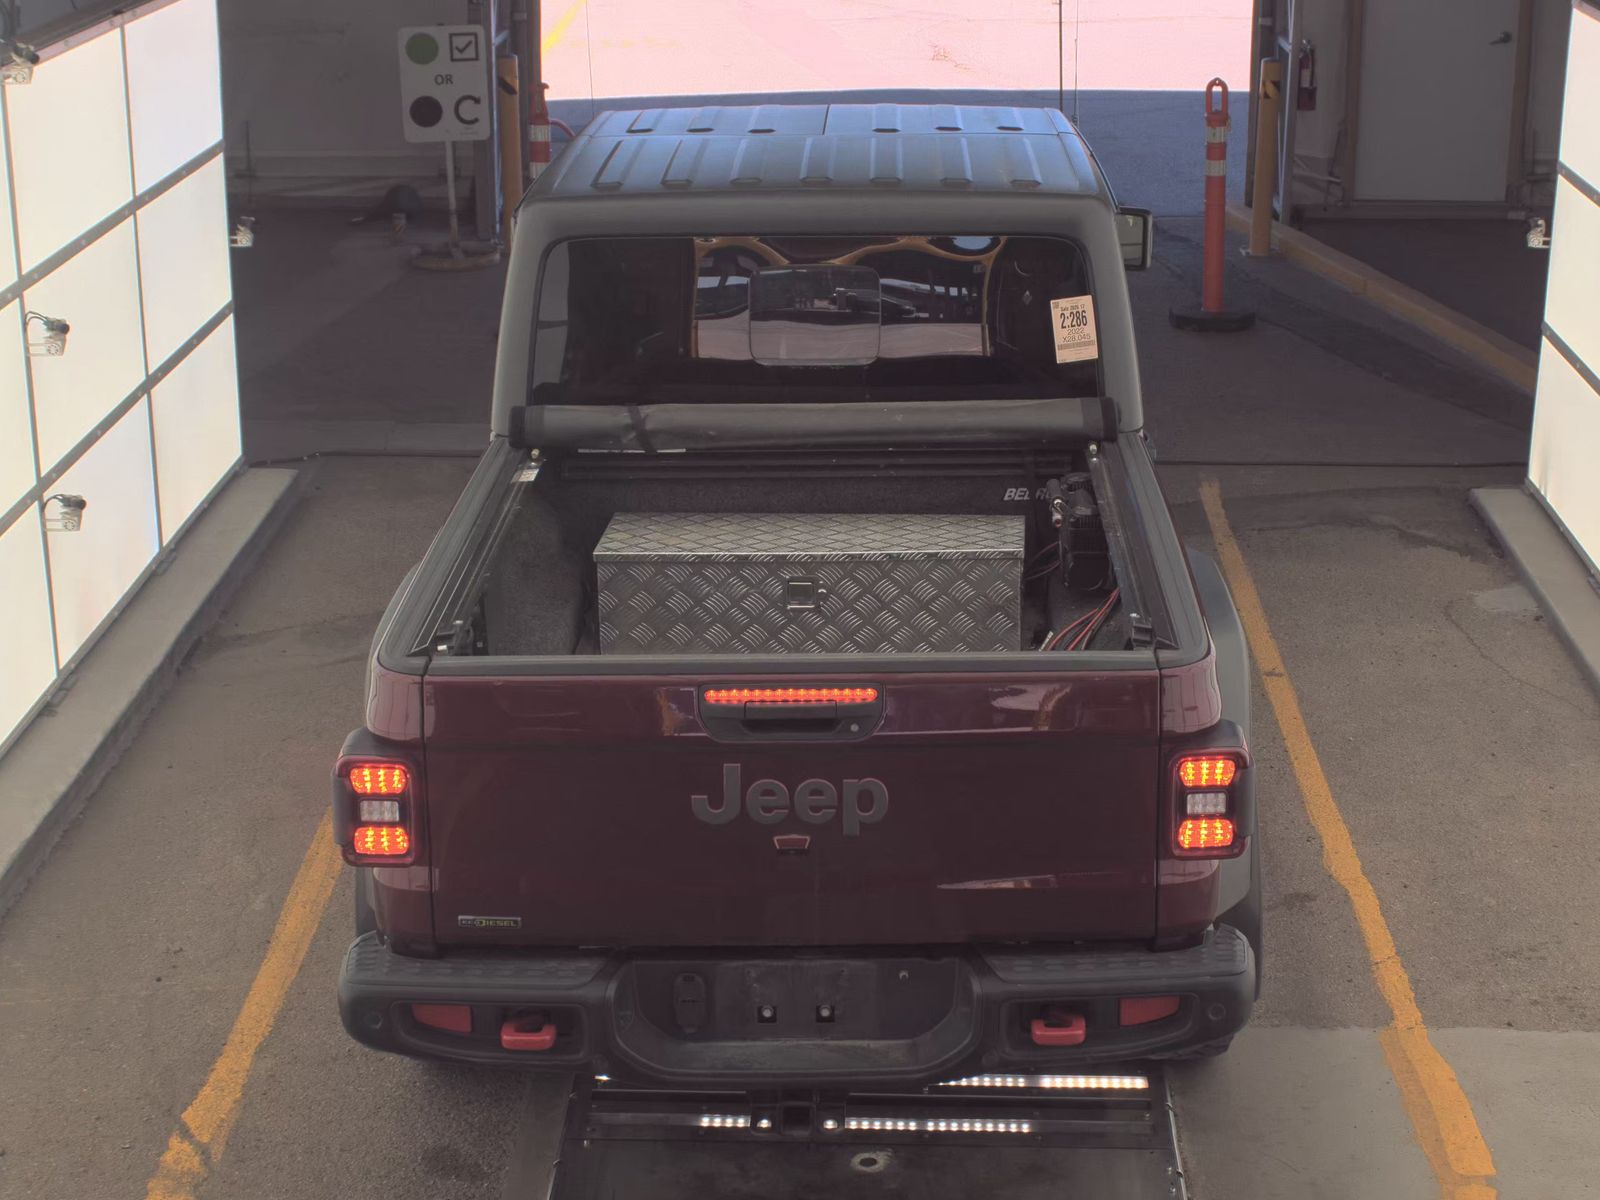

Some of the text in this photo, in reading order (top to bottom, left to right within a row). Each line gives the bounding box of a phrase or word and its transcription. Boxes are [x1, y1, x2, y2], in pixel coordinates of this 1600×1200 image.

[434, 74, 454, 86] OR
[1060, 310, 1088, 329] 2:286
[1067, 327, 1085, 335] 2022
[691, 763, 889, 836] Jeep
